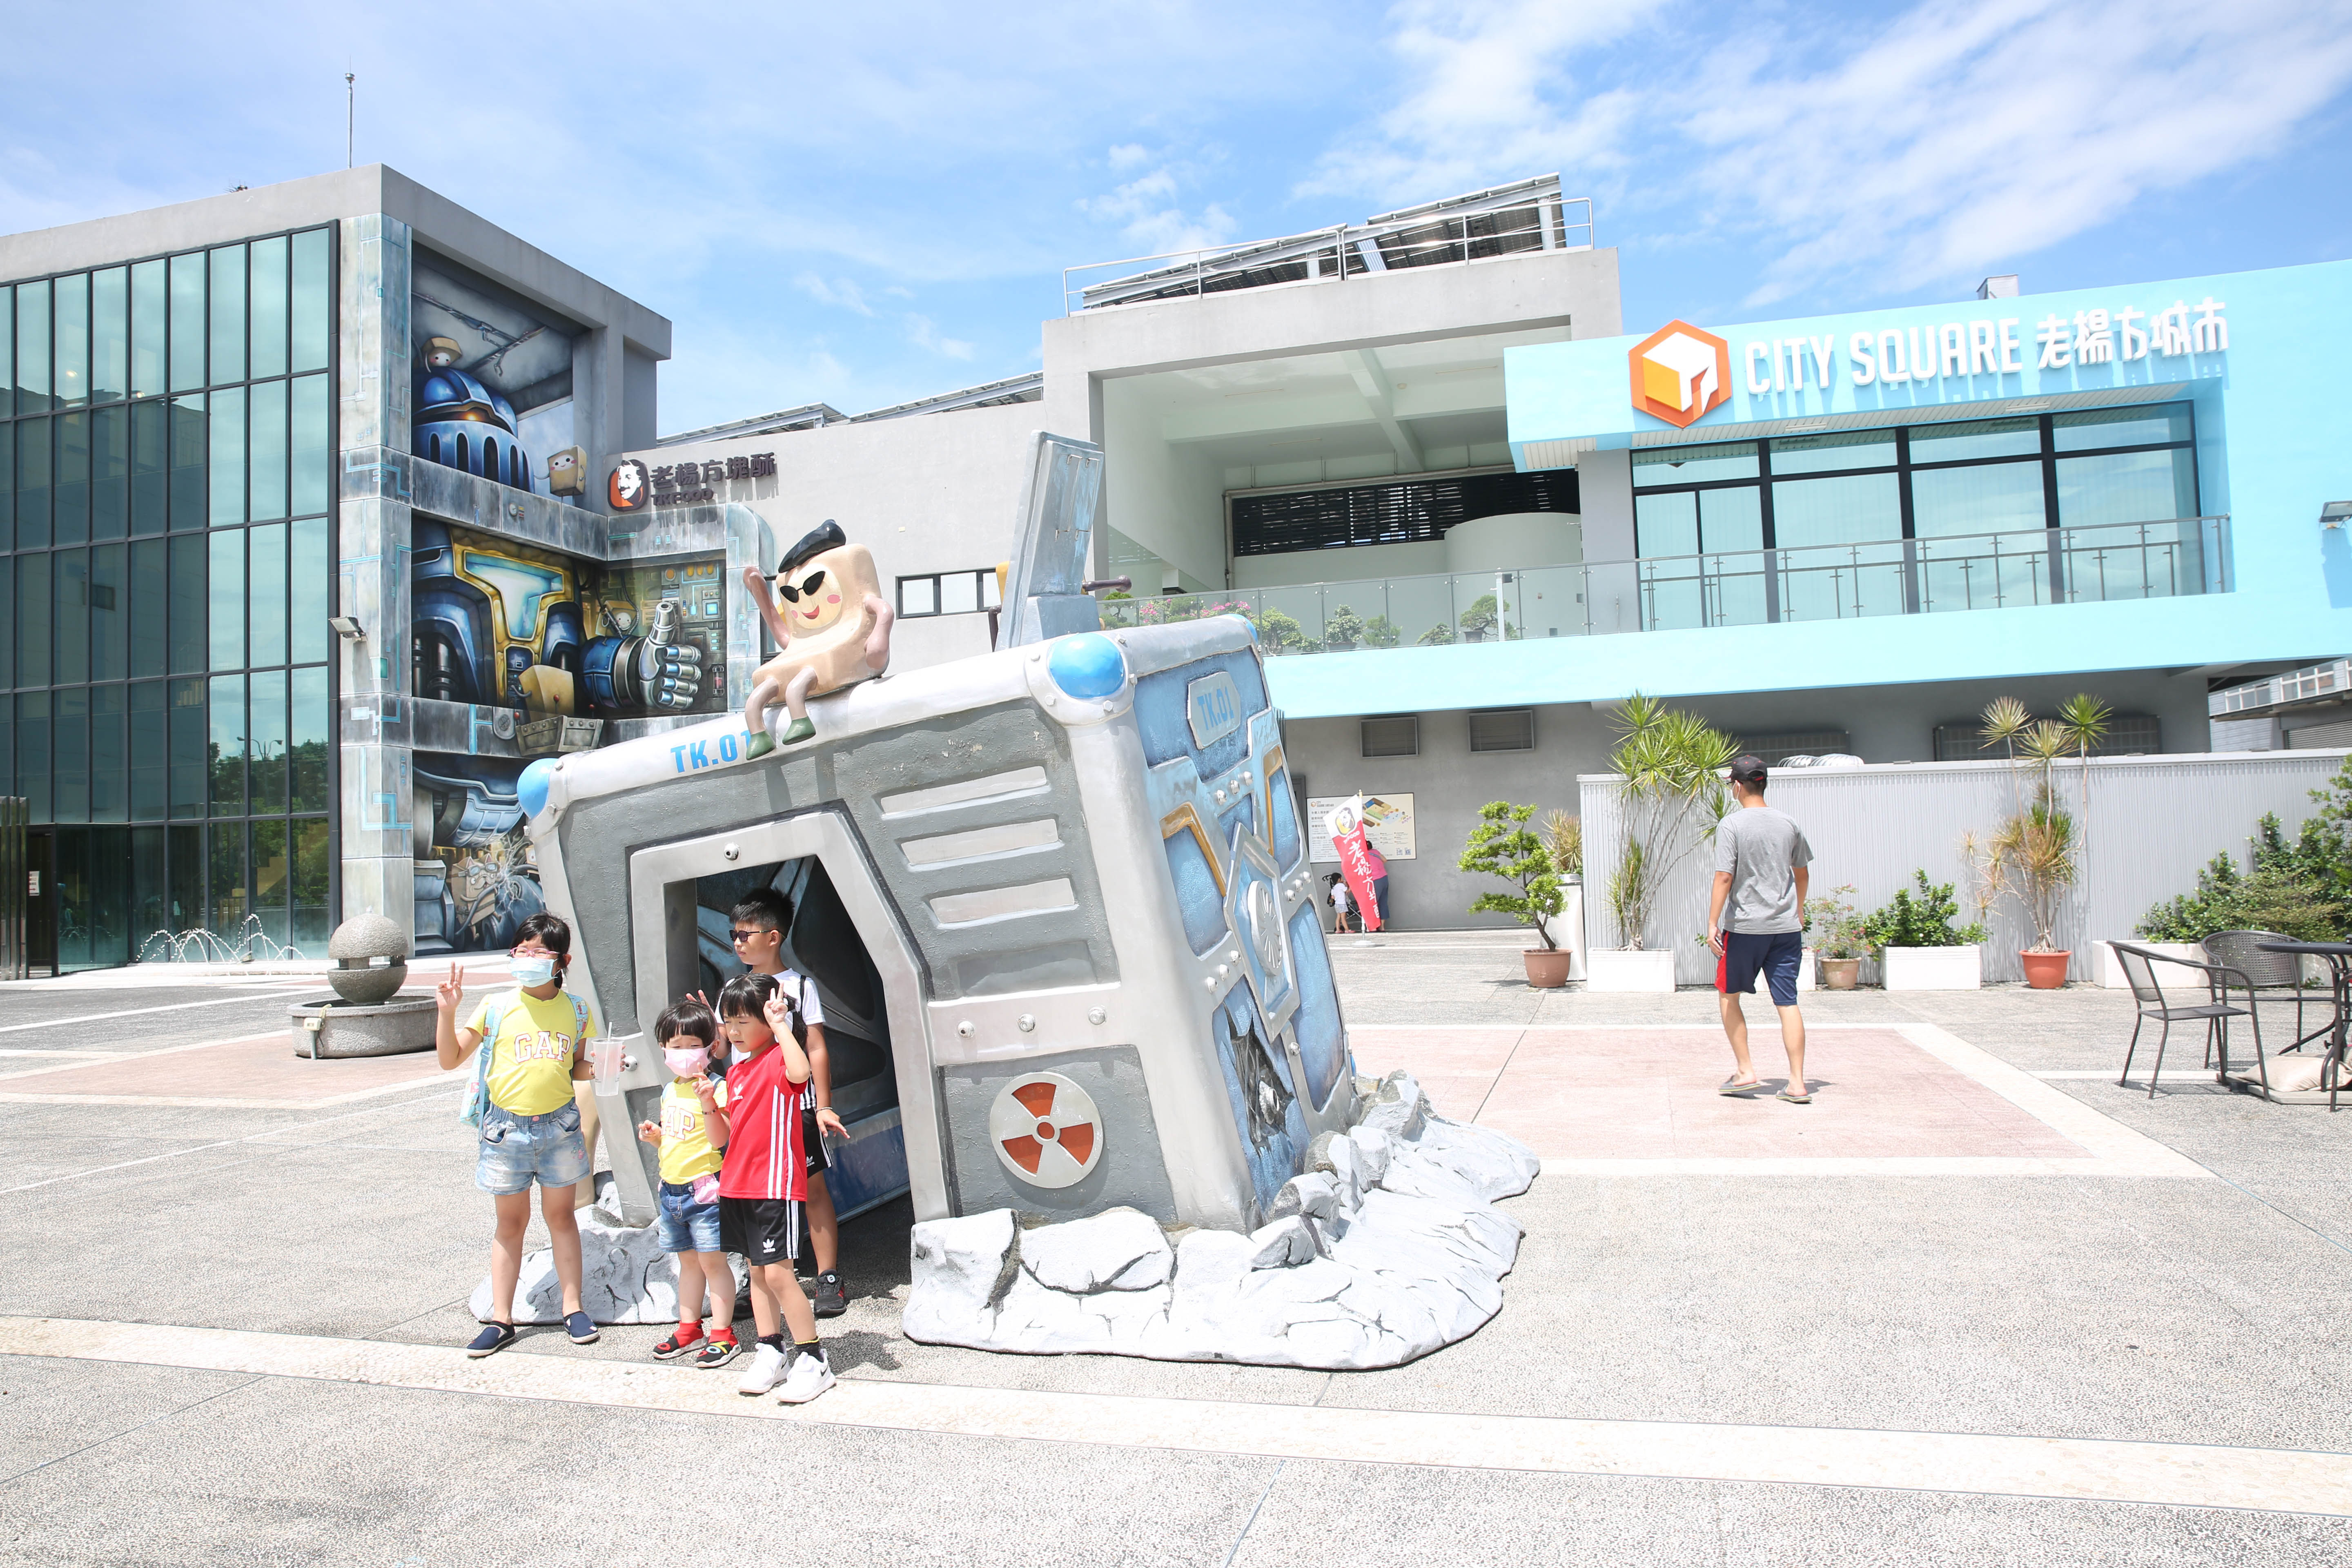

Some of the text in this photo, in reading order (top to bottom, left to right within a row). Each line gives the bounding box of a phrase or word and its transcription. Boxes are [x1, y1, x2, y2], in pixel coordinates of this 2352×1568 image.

[1745, 296, 2229, 394] CITY SQUARE 老楊方城市
[650, 452, 775, 490] 老楊方塊酥
[650, 488, 714, 506] TKFOOD
[1197, 686, 1235, 730] TK.01
[514, 1031, 572, 1063] GAP
[660, 1106, 695, 1140] AP
